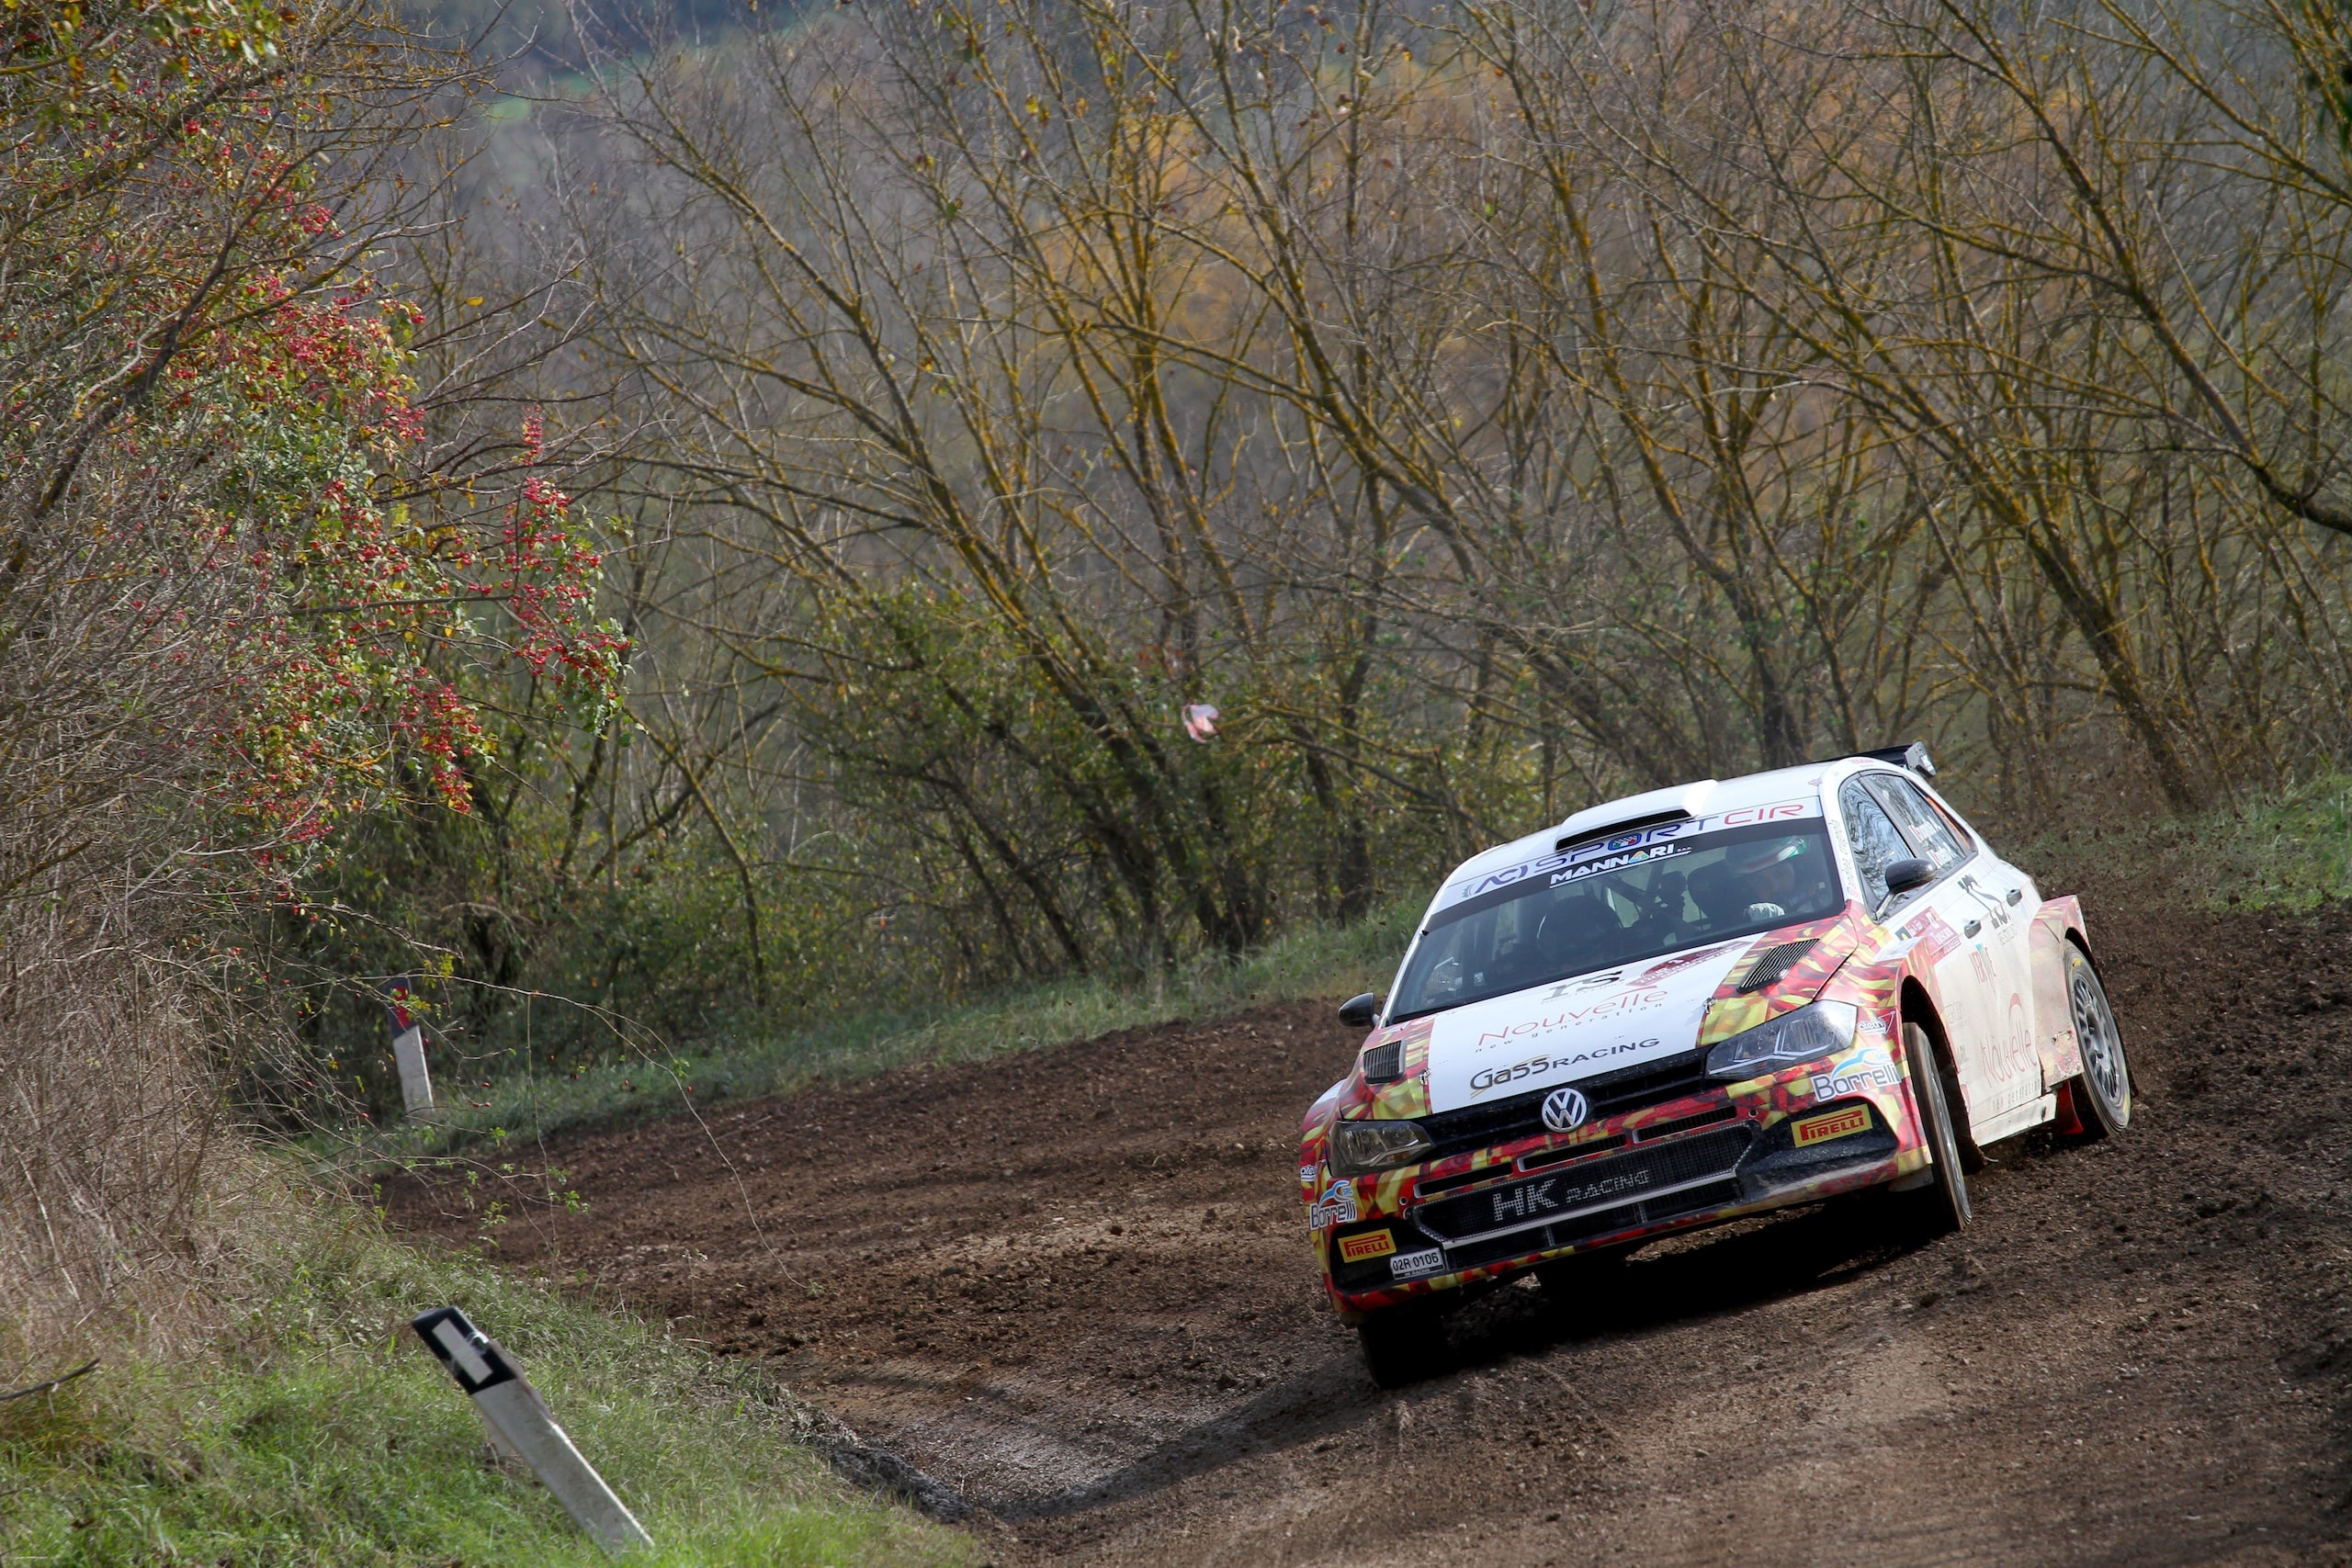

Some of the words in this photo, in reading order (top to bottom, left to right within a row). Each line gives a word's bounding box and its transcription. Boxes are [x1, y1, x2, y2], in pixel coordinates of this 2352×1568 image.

[1550, 843, 1675, 885] MANNARI
[1475, 1039, 1513, 1053] new
[1532, 1002, 1662, 1038] generation
[1799, 1110, 1864, 1141] PIRELLI
[1493, 1179, 1559, 1222] HK
[1566, 1169, 1650, 1203] RACING
[1344, 1234, 1390, 1258] PIRELLI
[1392, 1258, 1411, 1271] 02R
[1412, 1252, 1439, 1268] 0106
